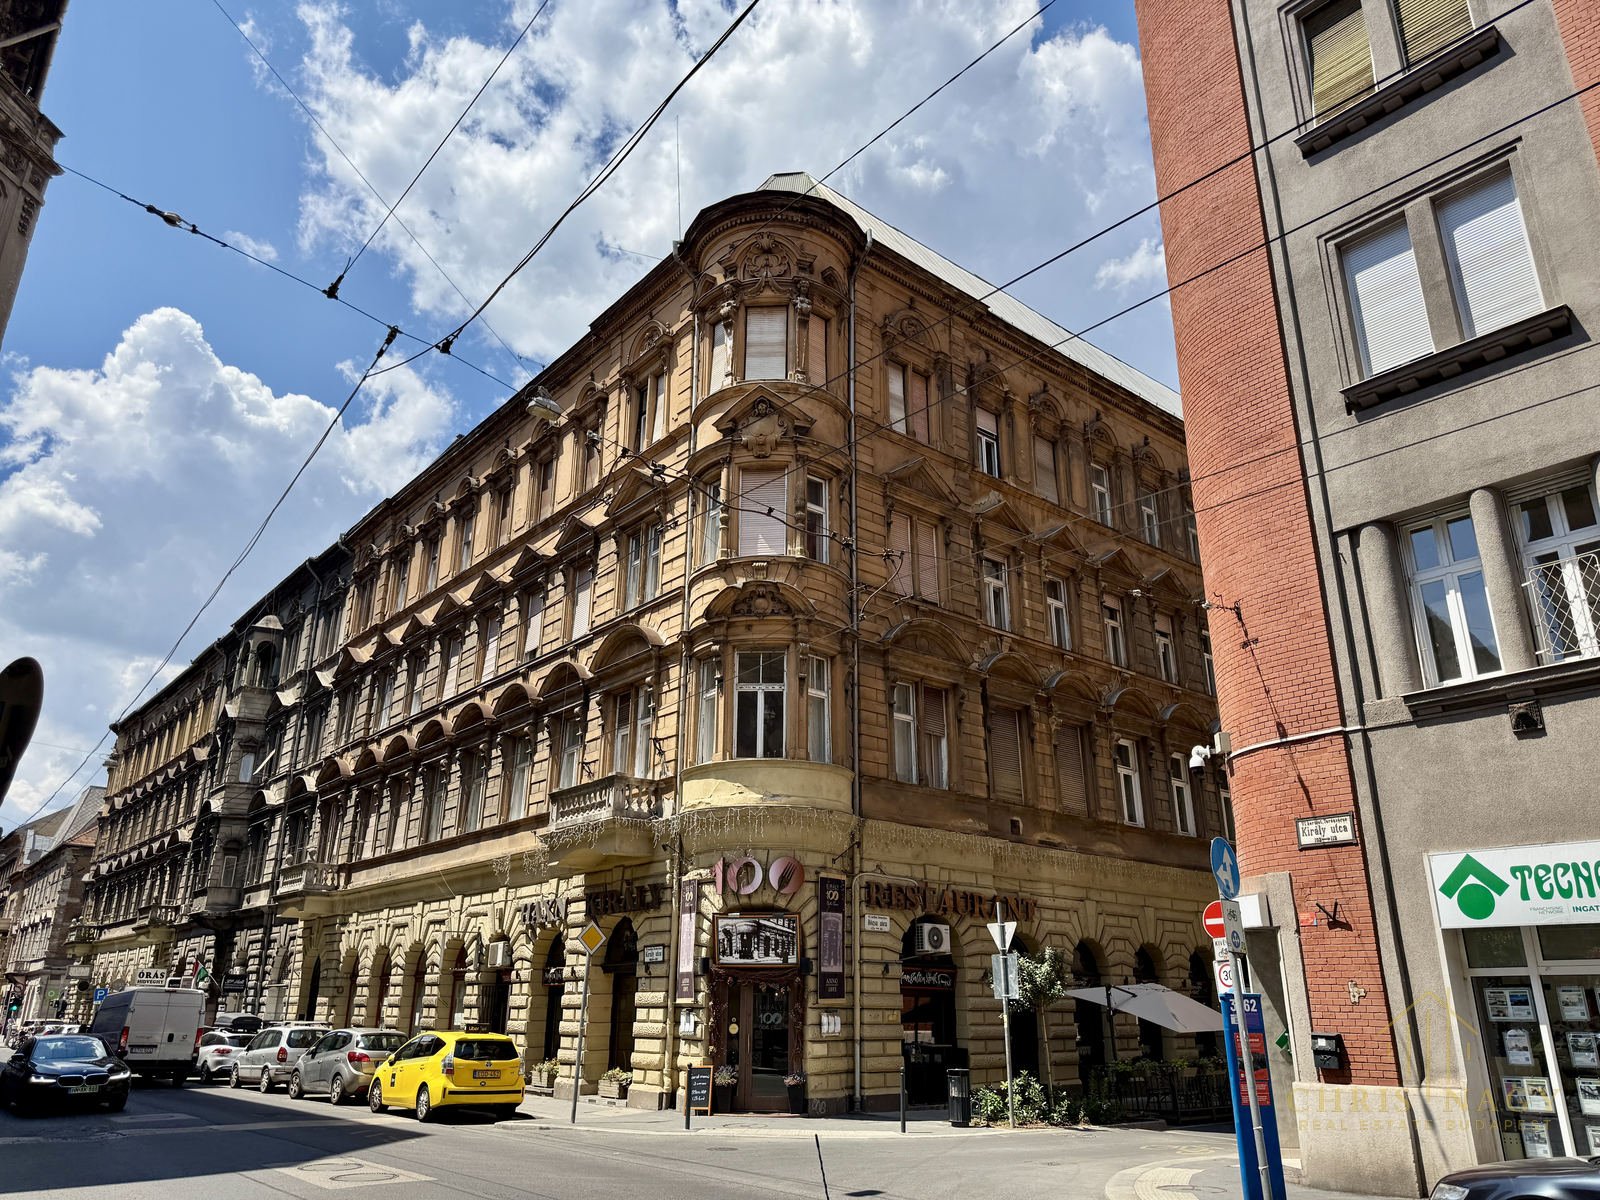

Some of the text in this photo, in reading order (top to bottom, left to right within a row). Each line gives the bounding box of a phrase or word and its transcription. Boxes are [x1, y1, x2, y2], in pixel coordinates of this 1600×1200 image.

[1301, 823, 1348, 837] Király utca
[520, 898, 568, 925] HAXN
[138, 969, 166, 979] ÓRÁS
[97, 990, 105, 999] P
